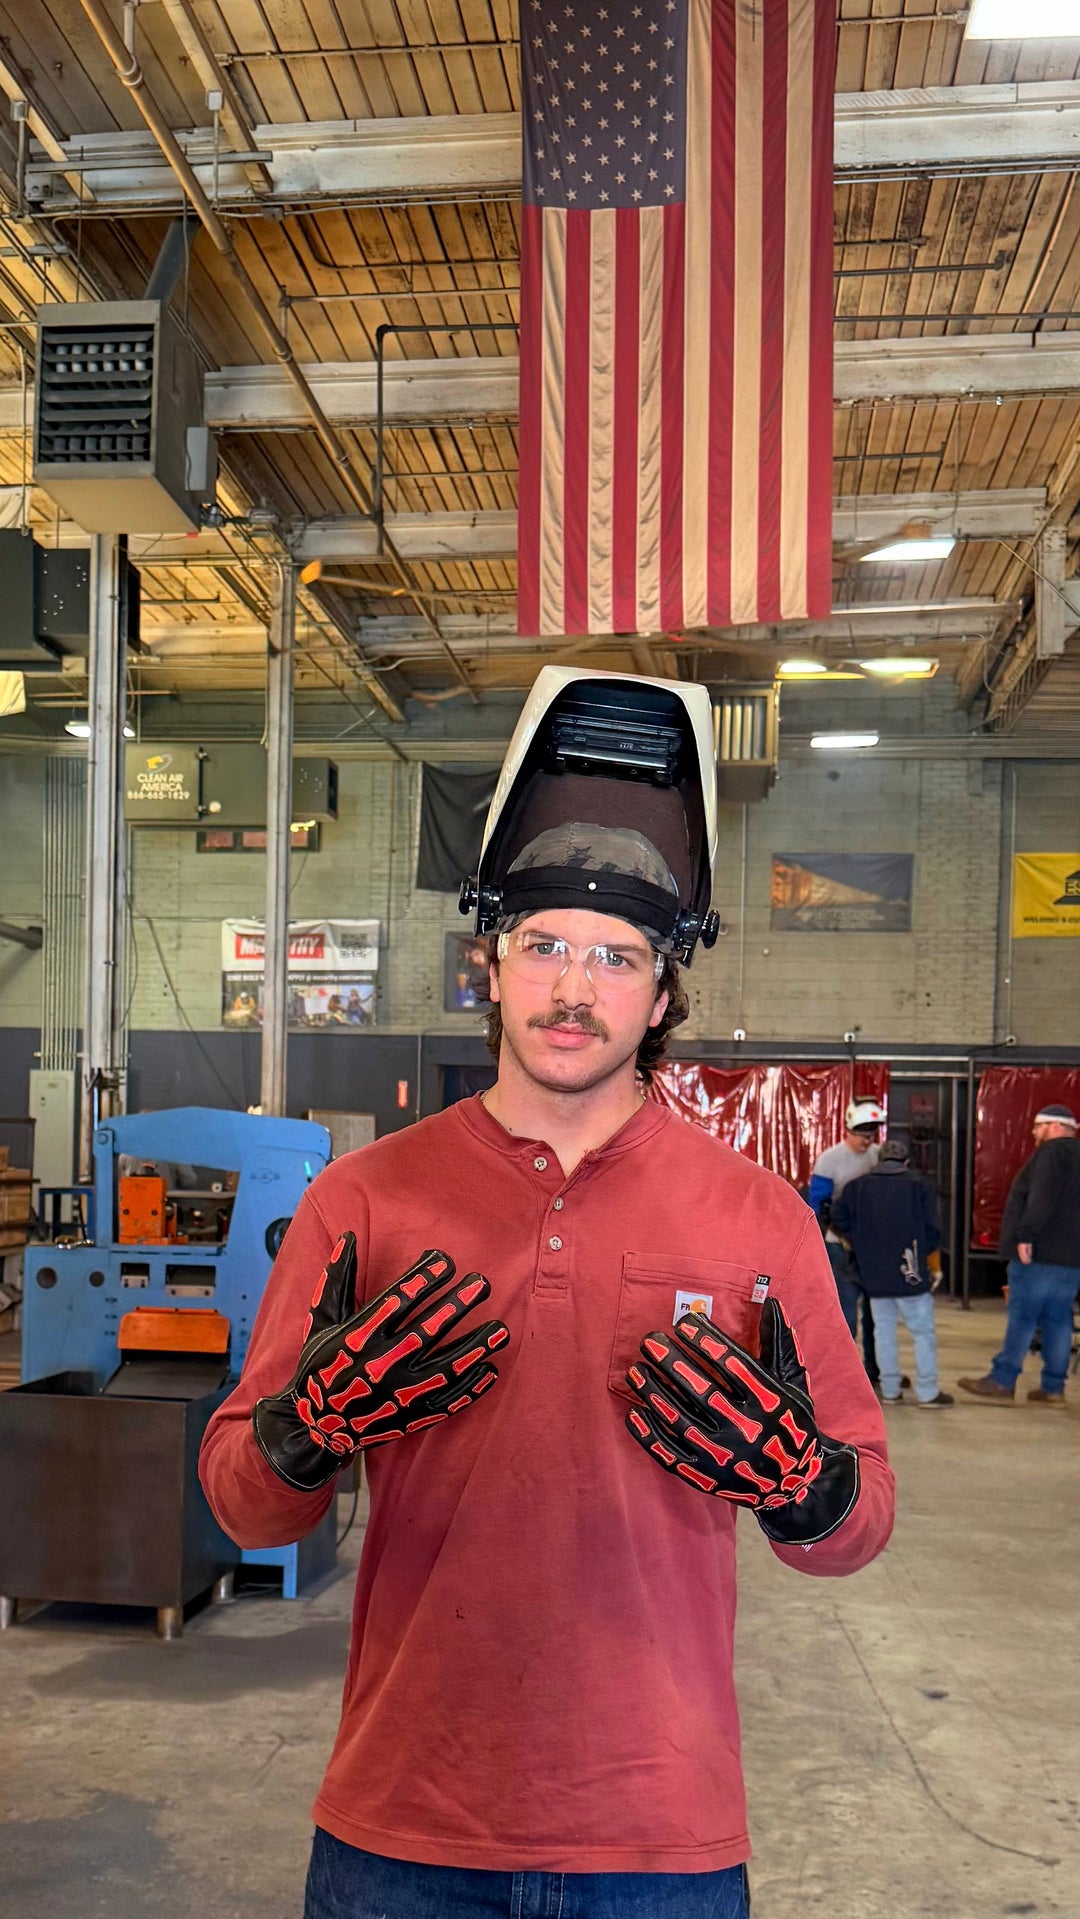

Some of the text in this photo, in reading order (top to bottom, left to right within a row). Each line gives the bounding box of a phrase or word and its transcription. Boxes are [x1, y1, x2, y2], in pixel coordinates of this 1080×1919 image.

[136, 773, 184, 783] CLEAN AIR
[141, 783, 182, 791] AMERICA
